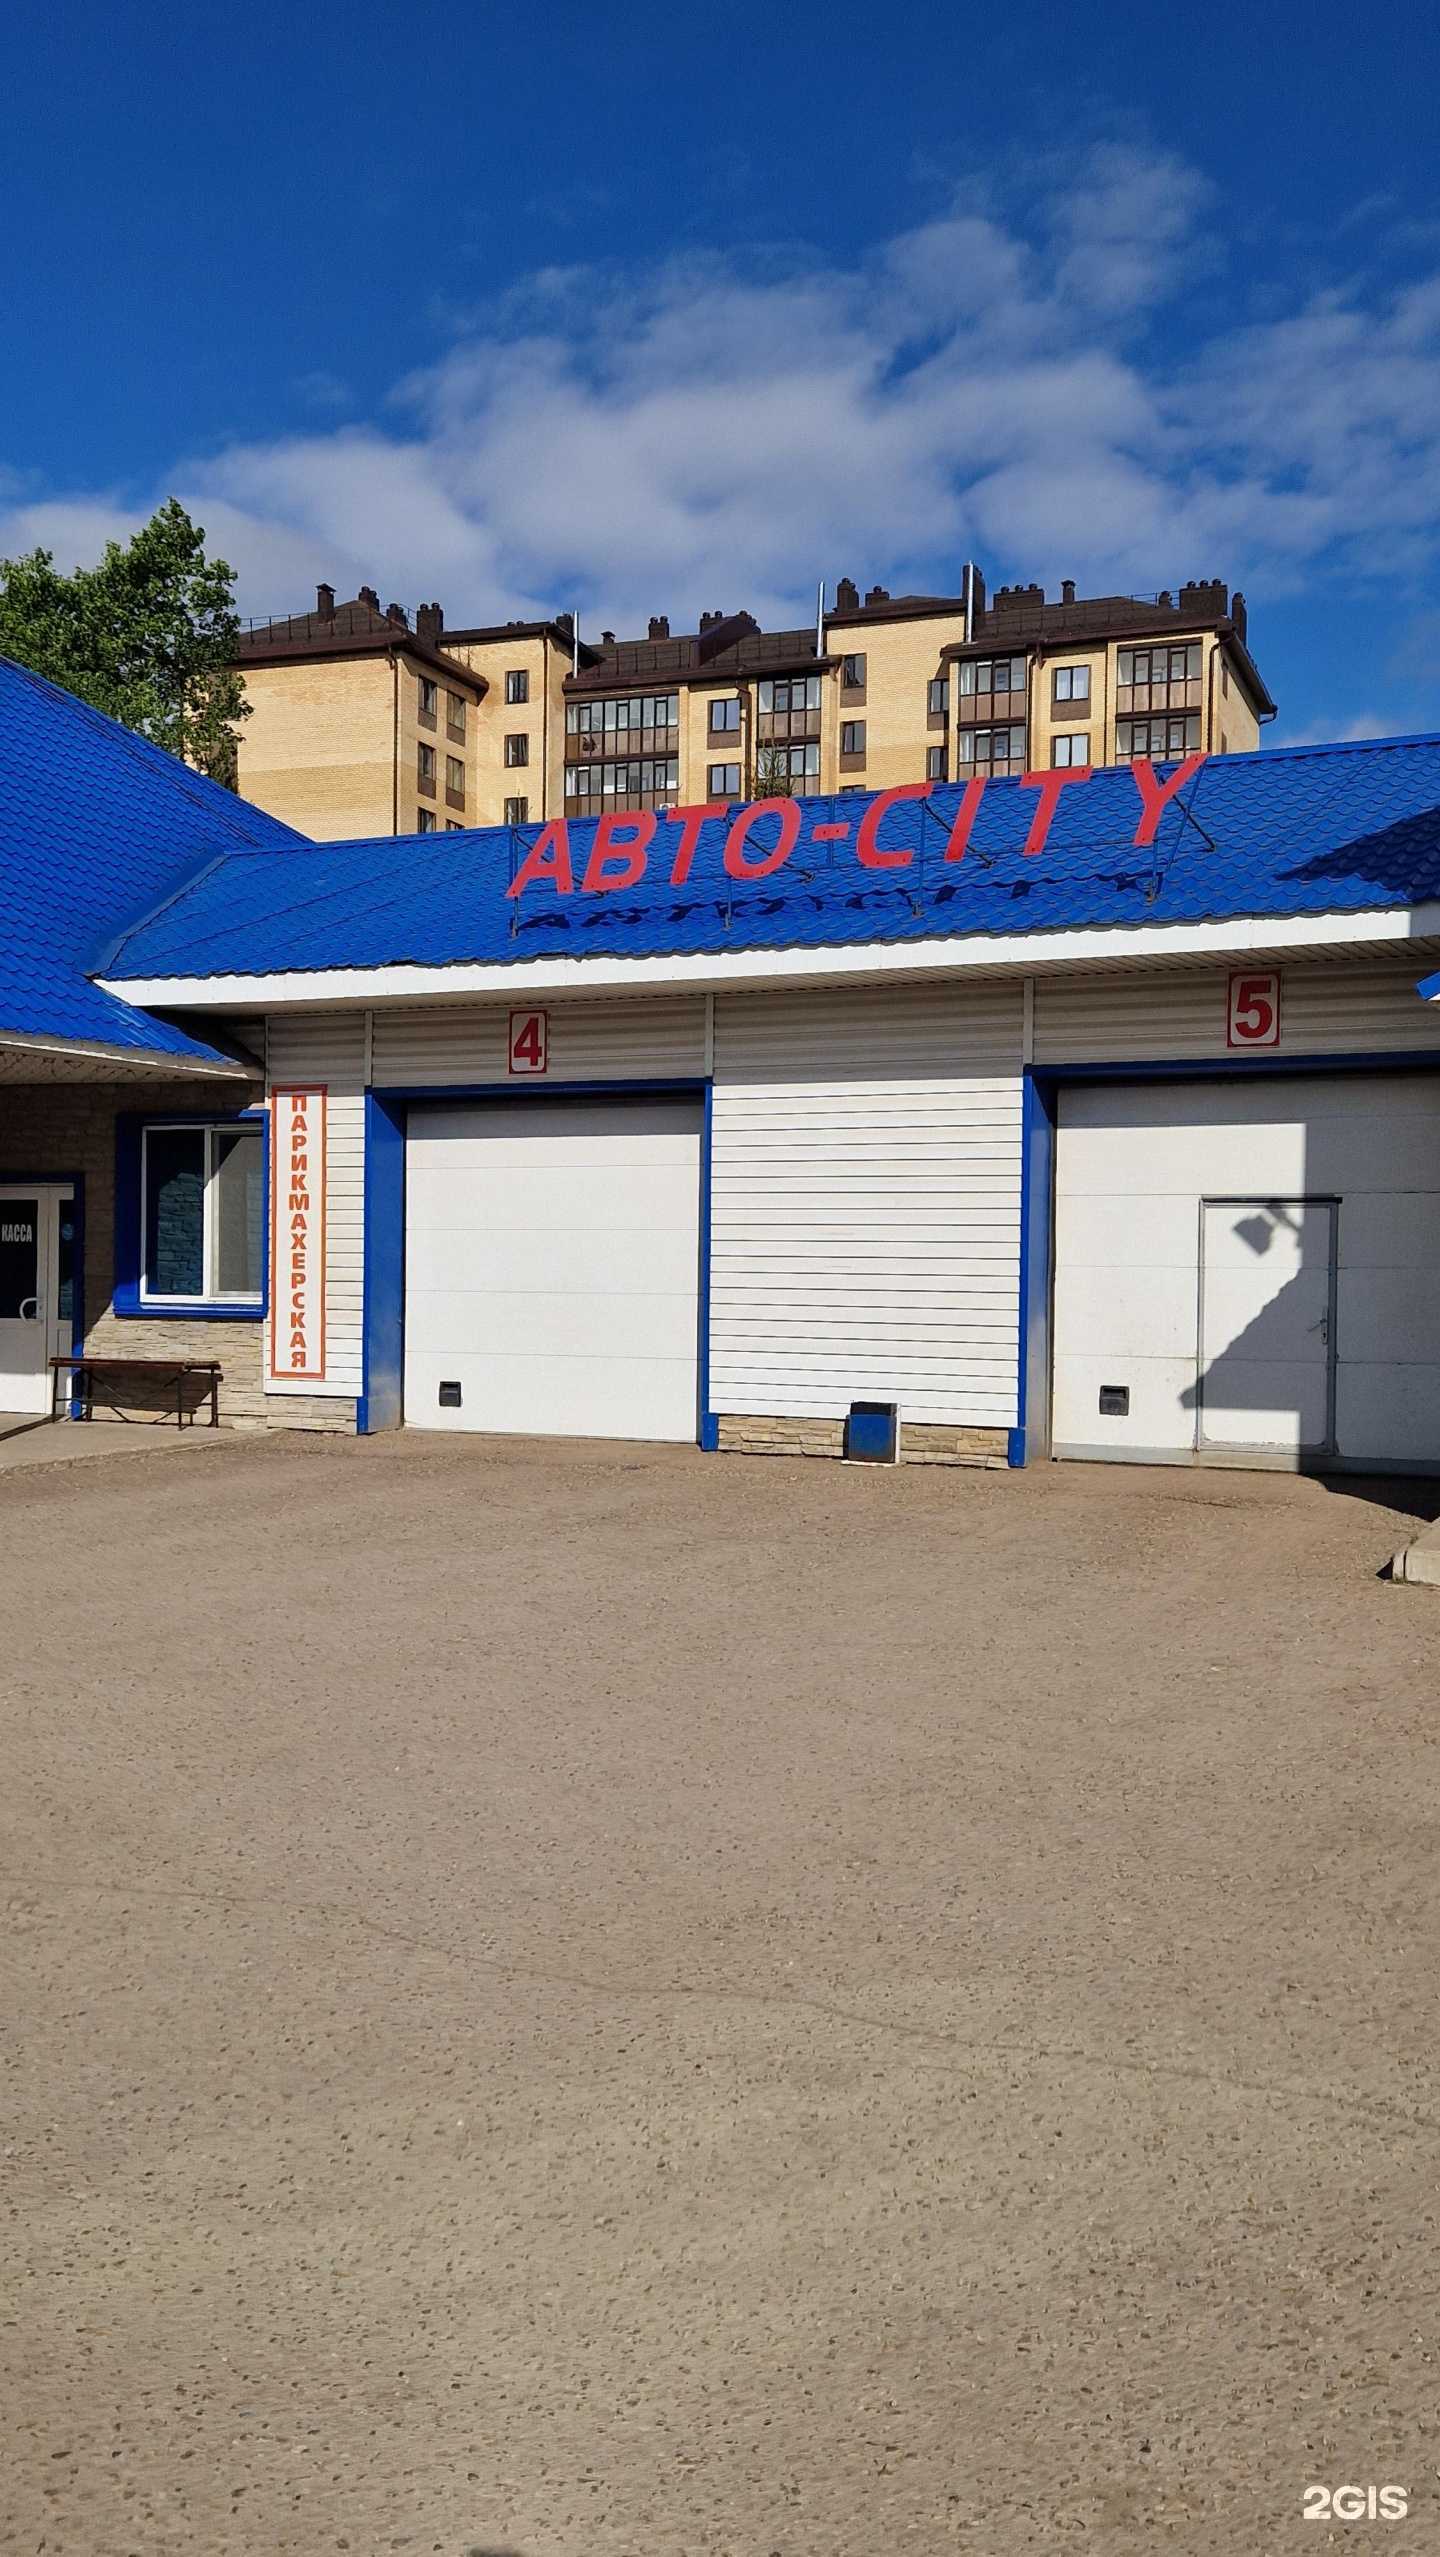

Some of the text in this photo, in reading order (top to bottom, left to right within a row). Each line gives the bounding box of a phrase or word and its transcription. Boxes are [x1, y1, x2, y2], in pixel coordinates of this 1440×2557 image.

[507, 753, 1209, 898] АВТО-CITY
[1235, 980, 1272, 1038] 5
[513, 1017, 542, 1066] 4
[1, 1224, 32, 1242] КАССА
[288, 1095, 309, 1368] ПАРИКМАХЕРСКАЯ
